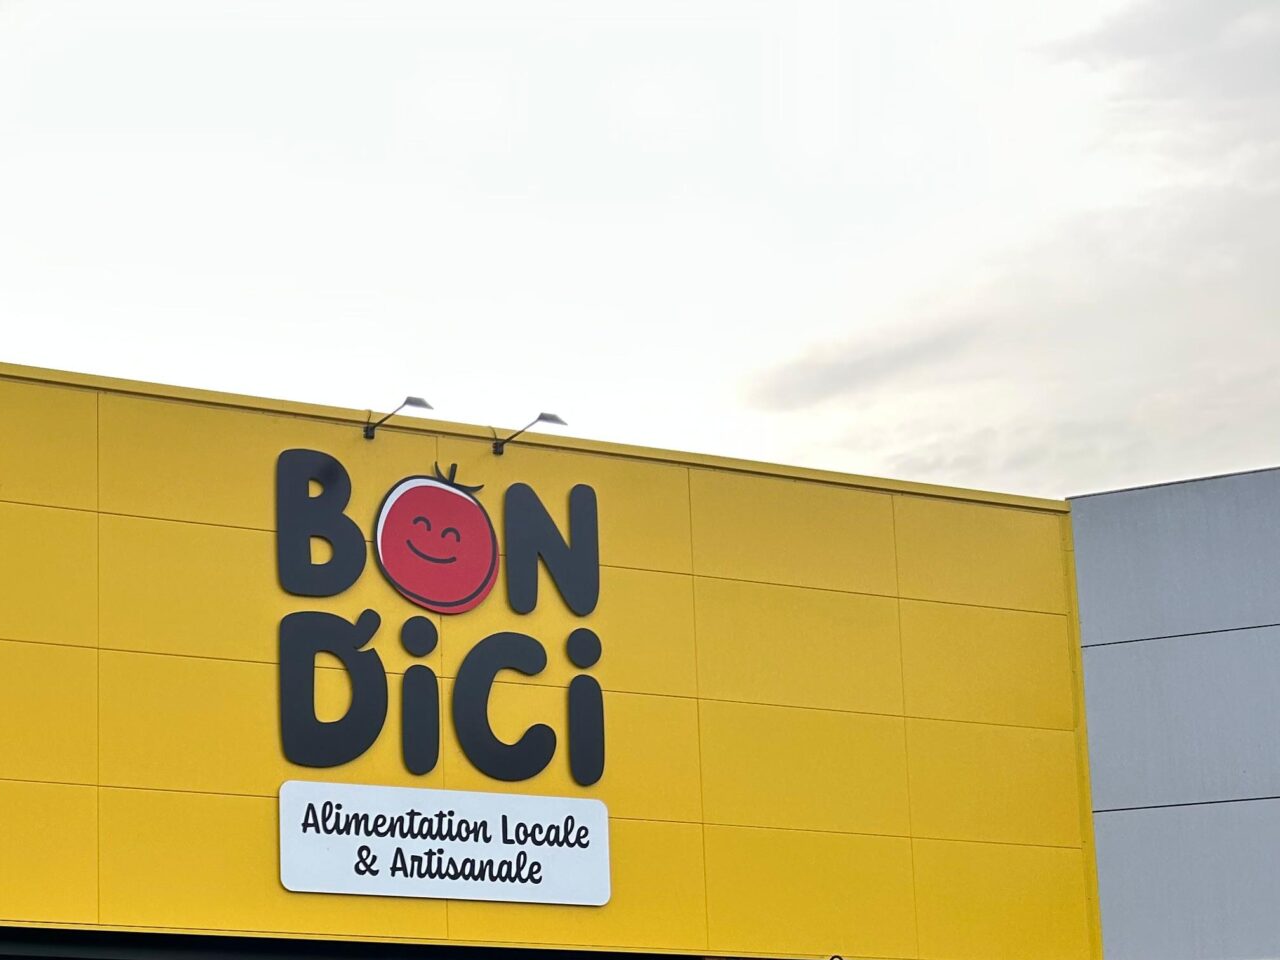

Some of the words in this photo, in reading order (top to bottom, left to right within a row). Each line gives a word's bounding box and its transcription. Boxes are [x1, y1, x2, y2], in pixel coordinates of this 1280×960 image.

[301, 801, 491, 844] Alimentation
[502, 815, 590, 849] Locale
[354, 846, 379, 876] &
[390, 848, 542, 884] Artisanale
